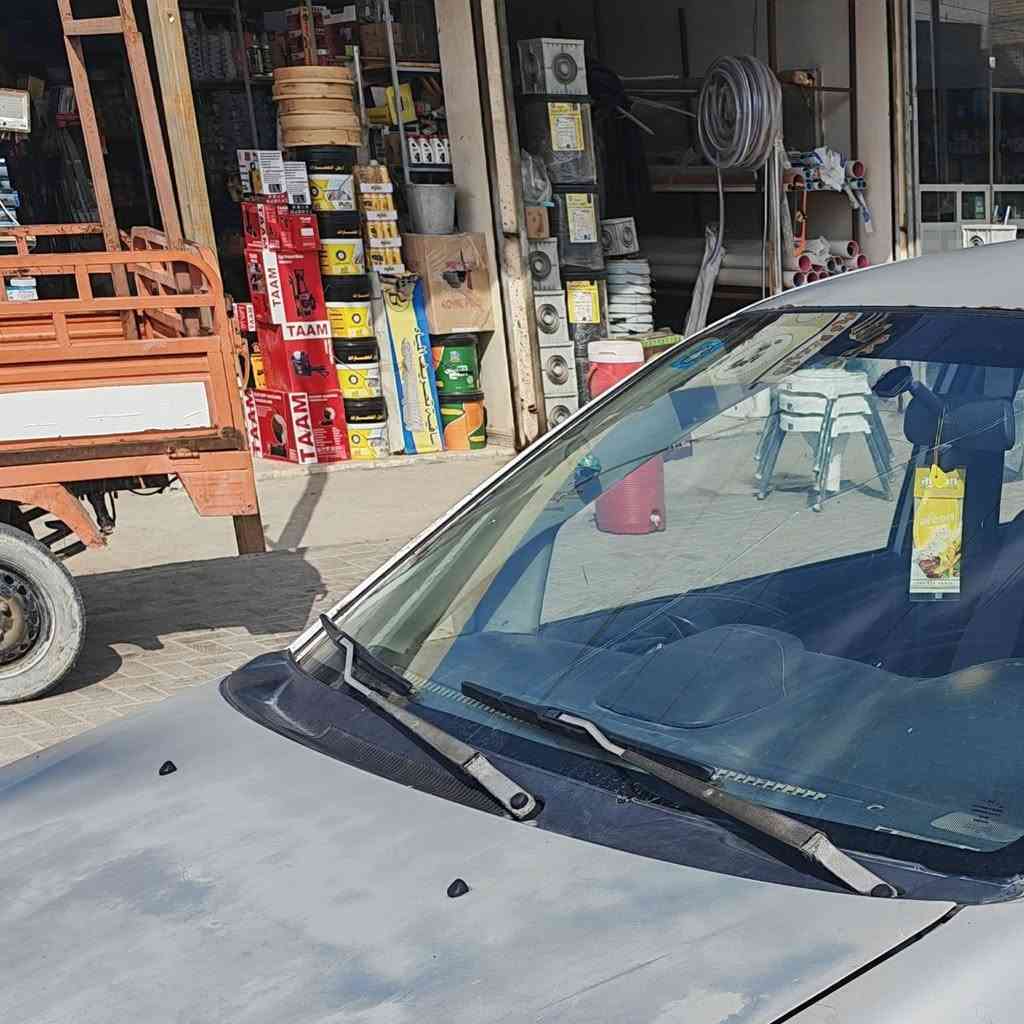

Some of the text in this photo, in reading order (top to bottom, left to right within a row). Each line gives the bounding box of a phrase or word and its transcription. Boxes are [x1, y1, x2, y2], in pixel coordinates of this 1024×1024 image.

[268, 268, 281, 308] TAAM
[287, 324, 328, 337] TAAM
[245, 389, 260, 453] TAAM
[292, 394, 315, 464] TAAM
